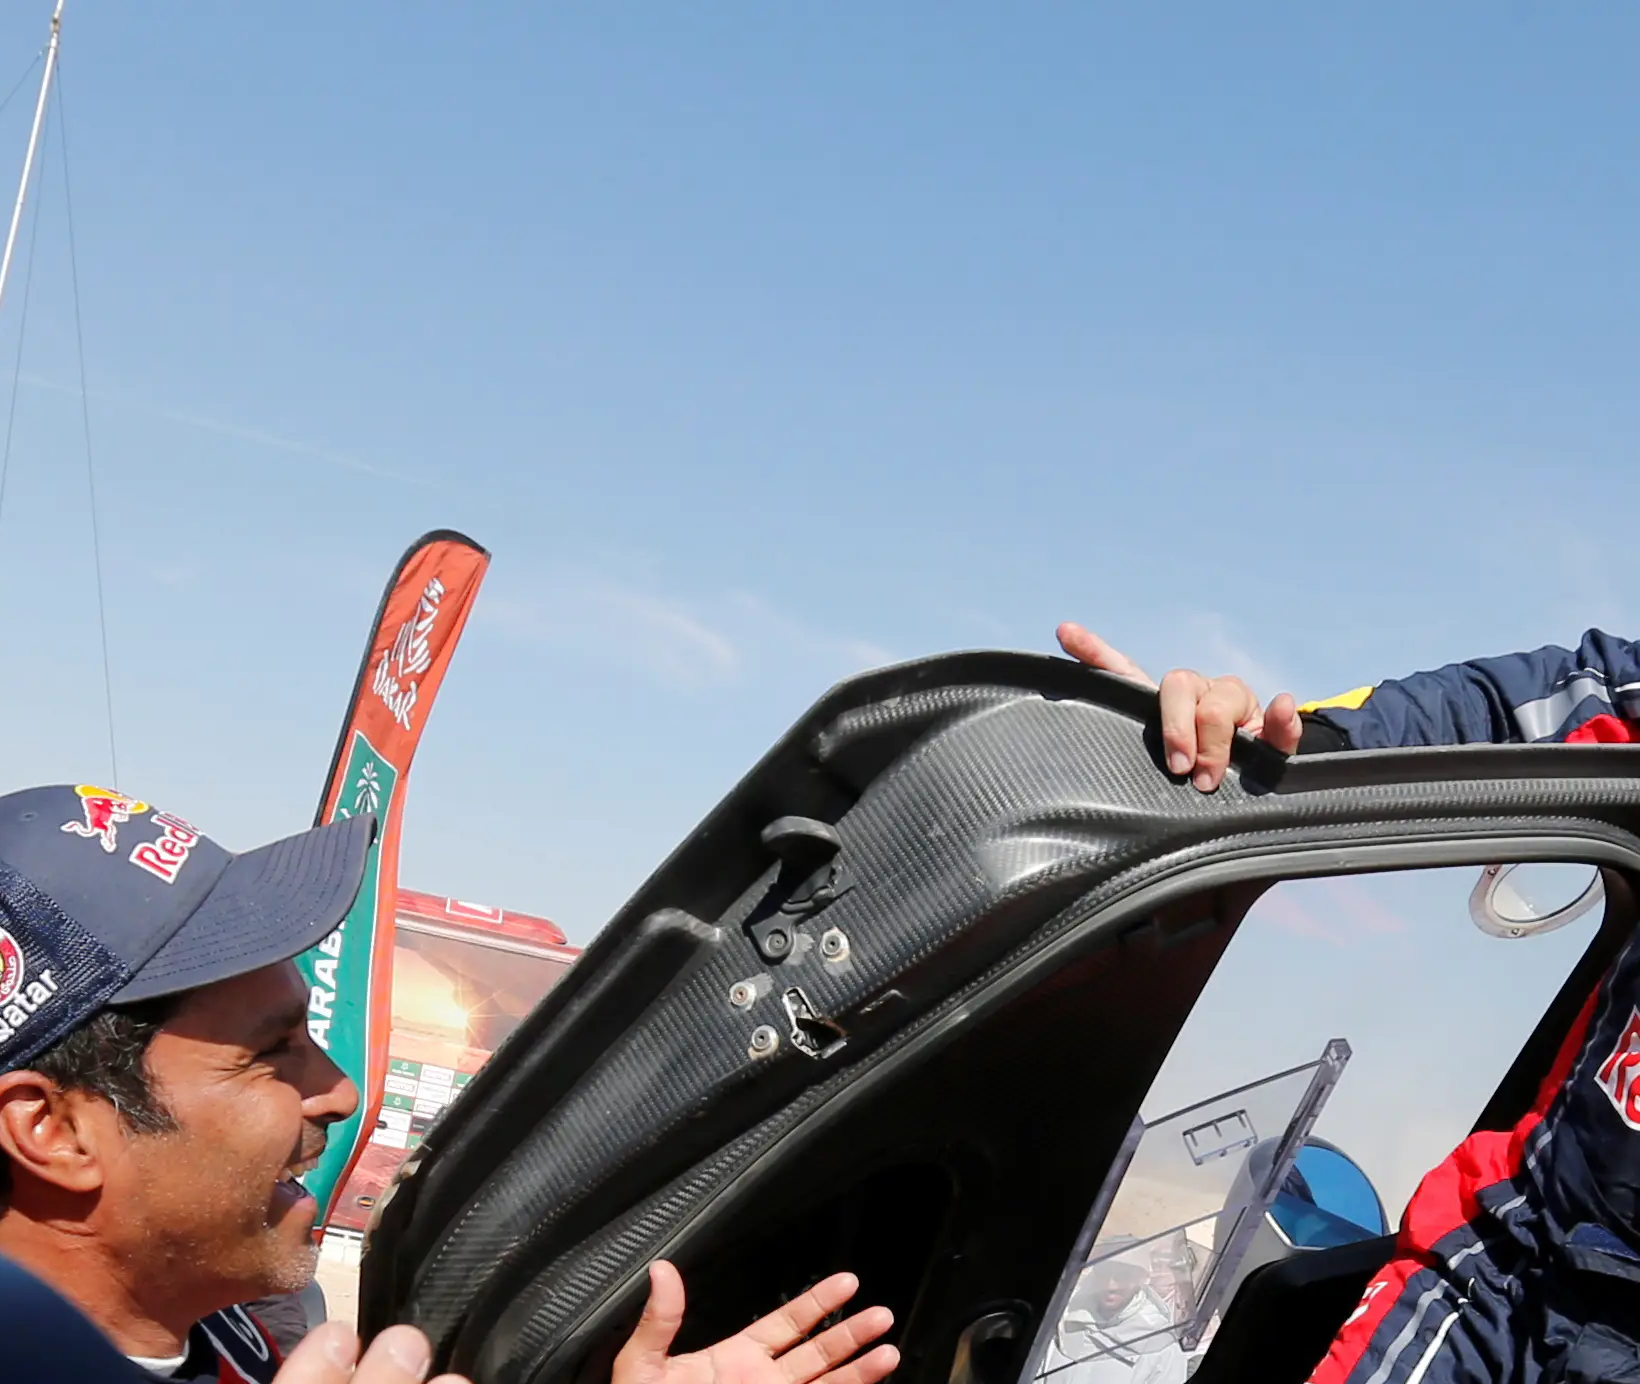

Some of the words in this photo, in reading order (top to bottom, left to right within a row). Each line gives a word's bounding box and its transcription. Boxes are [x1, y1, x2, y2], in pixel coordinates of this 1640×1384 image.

[373, 650, 417, 730] DAKAR
[129, 812, 199, 885] Red
[306, 921, 347, 1050] ARAB
